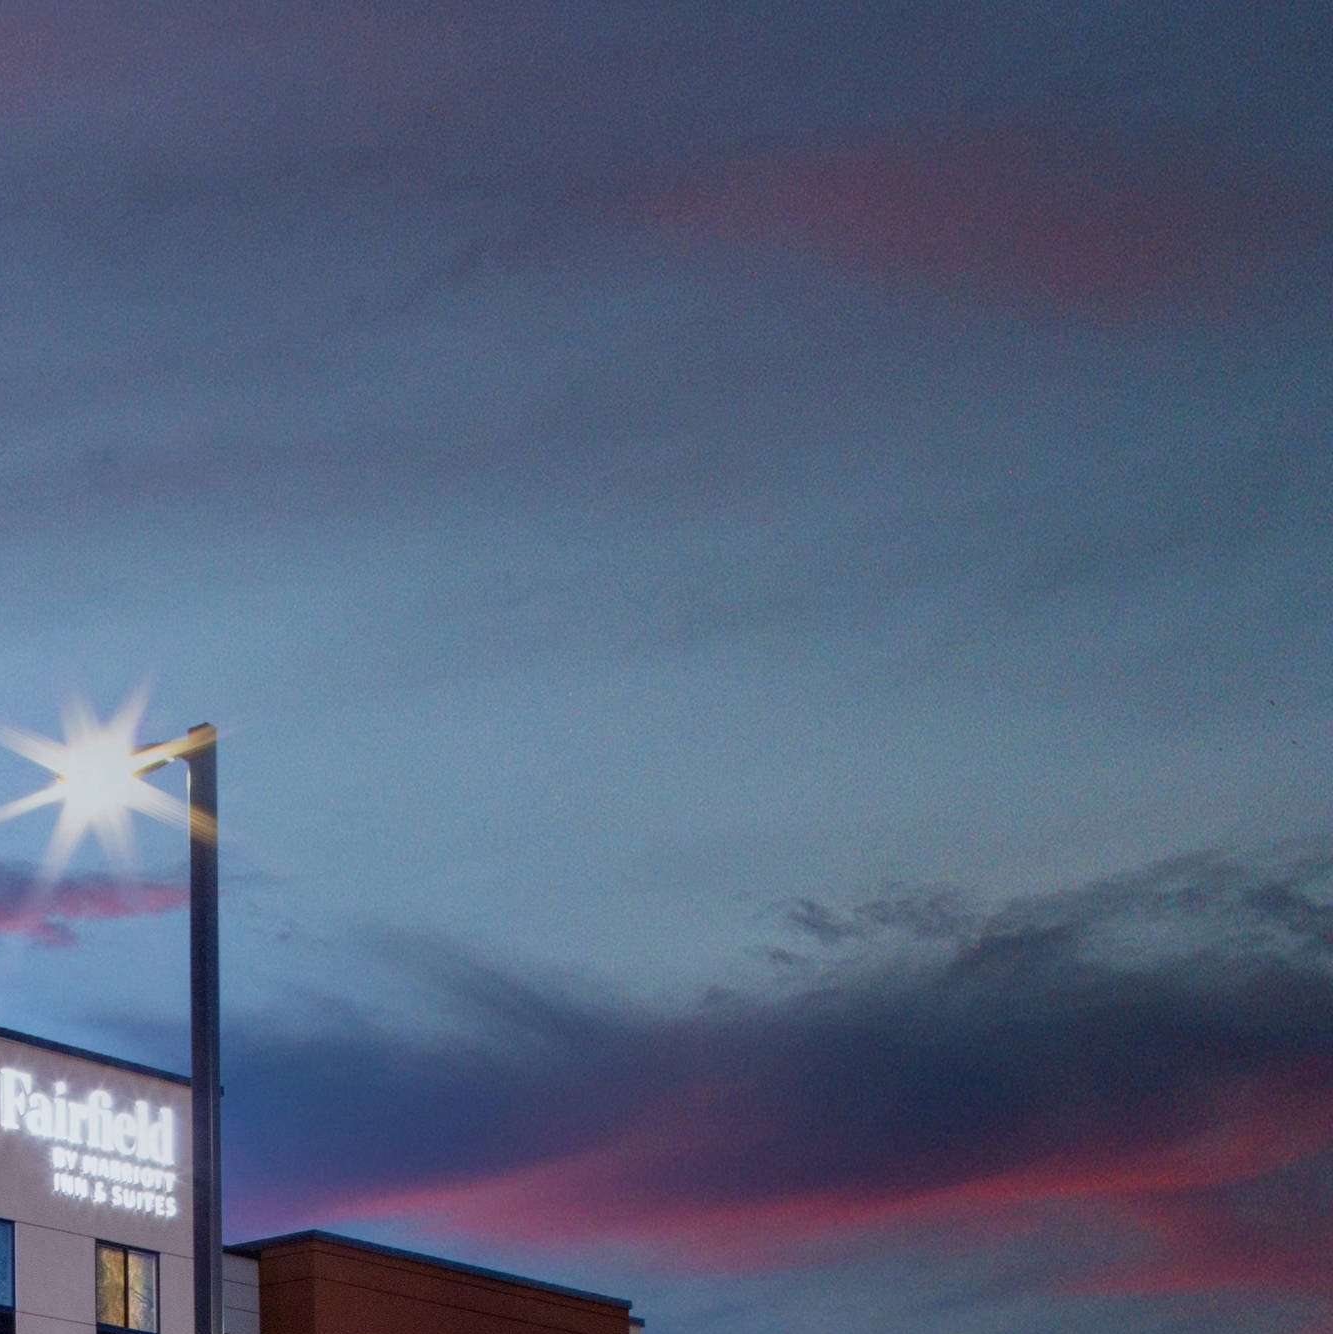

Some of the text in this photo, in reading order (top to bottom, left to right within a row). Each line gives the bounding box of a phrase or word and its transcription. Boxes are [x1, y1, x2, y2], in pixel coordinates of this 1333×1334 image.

[0, 1067, 175, 1166] Fairfield
[51, 1146, 176, 1193] BY MARRIOTT
[53, 1172, 177, 1217] INN & SUITES
